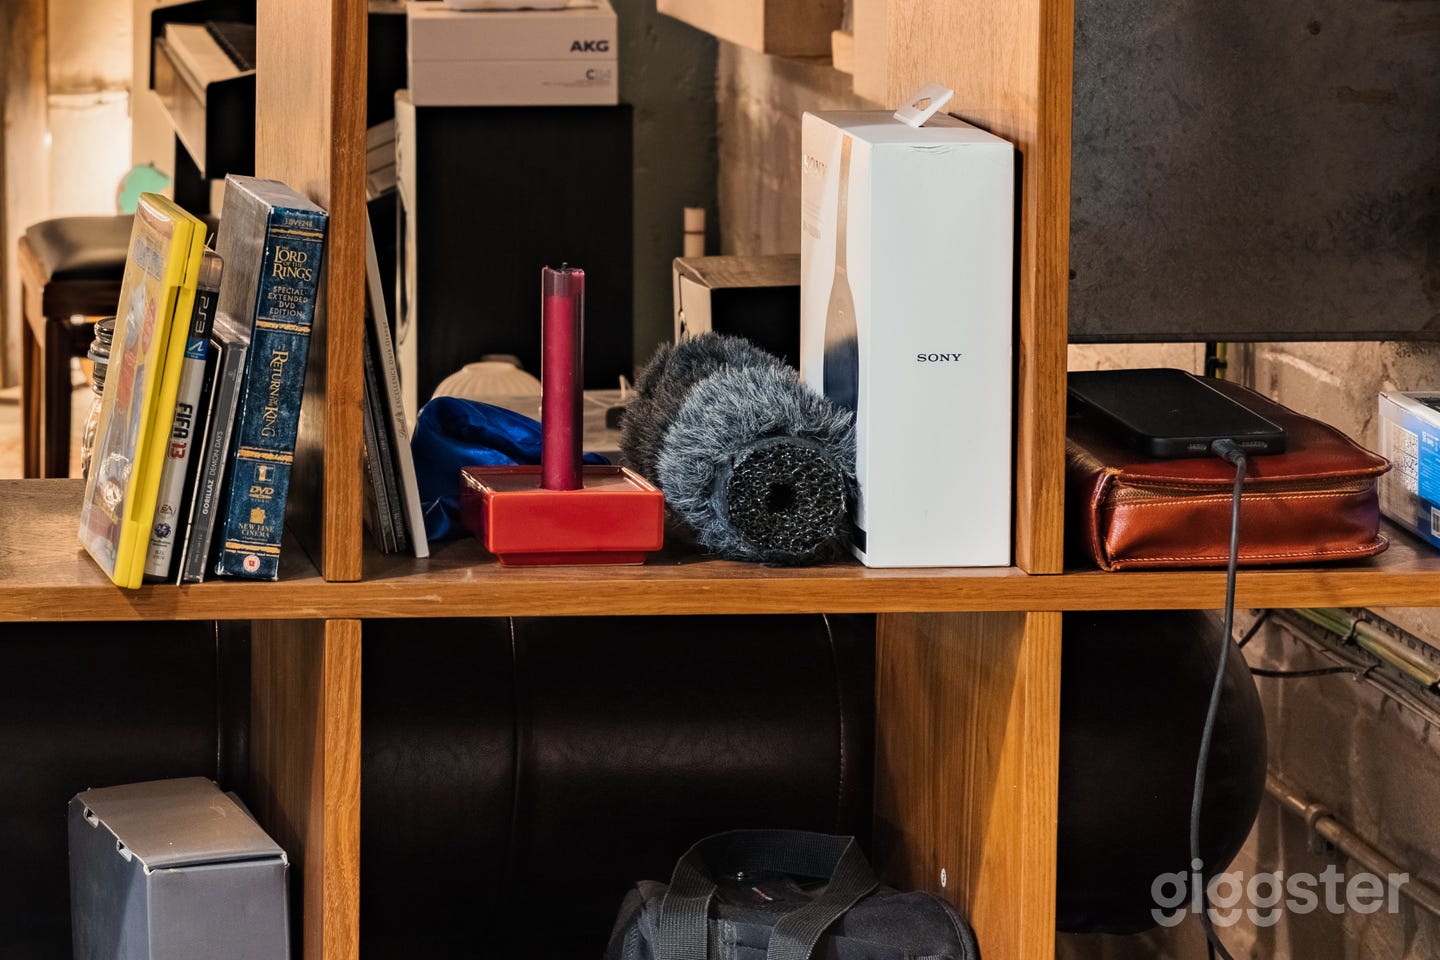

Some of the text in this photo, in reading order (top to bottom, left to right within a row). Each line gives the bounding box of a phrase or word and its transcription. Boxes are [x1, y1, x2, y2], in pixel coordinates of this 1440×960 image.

[569, 40, 609, 53] AKG
[274, 245, 307, 263] LORD
[272, 263, 313, 282] RINGS
[273, 285, 304, 296] SPECIAL
[268, 292, 308, 303] EXTENDED
[279, 301, 296, 309] DVD
[195, 295, 210, 334] PS3
[269, 307, 303, 317] EDITION
[917, 353, 962, 362] SONY
[269, 349, 289, 396] RETURN
[261, 406, 278, 437] KING
[170, 402, 193, 459] FIFA 13
[202, 431, 223, 515] GORILLAZ DEMON DAYS
[249, 485, 275, 495] DVD
[238, 522, 256, 531] NEW
[241, 529, 270, 538] CINEMA
